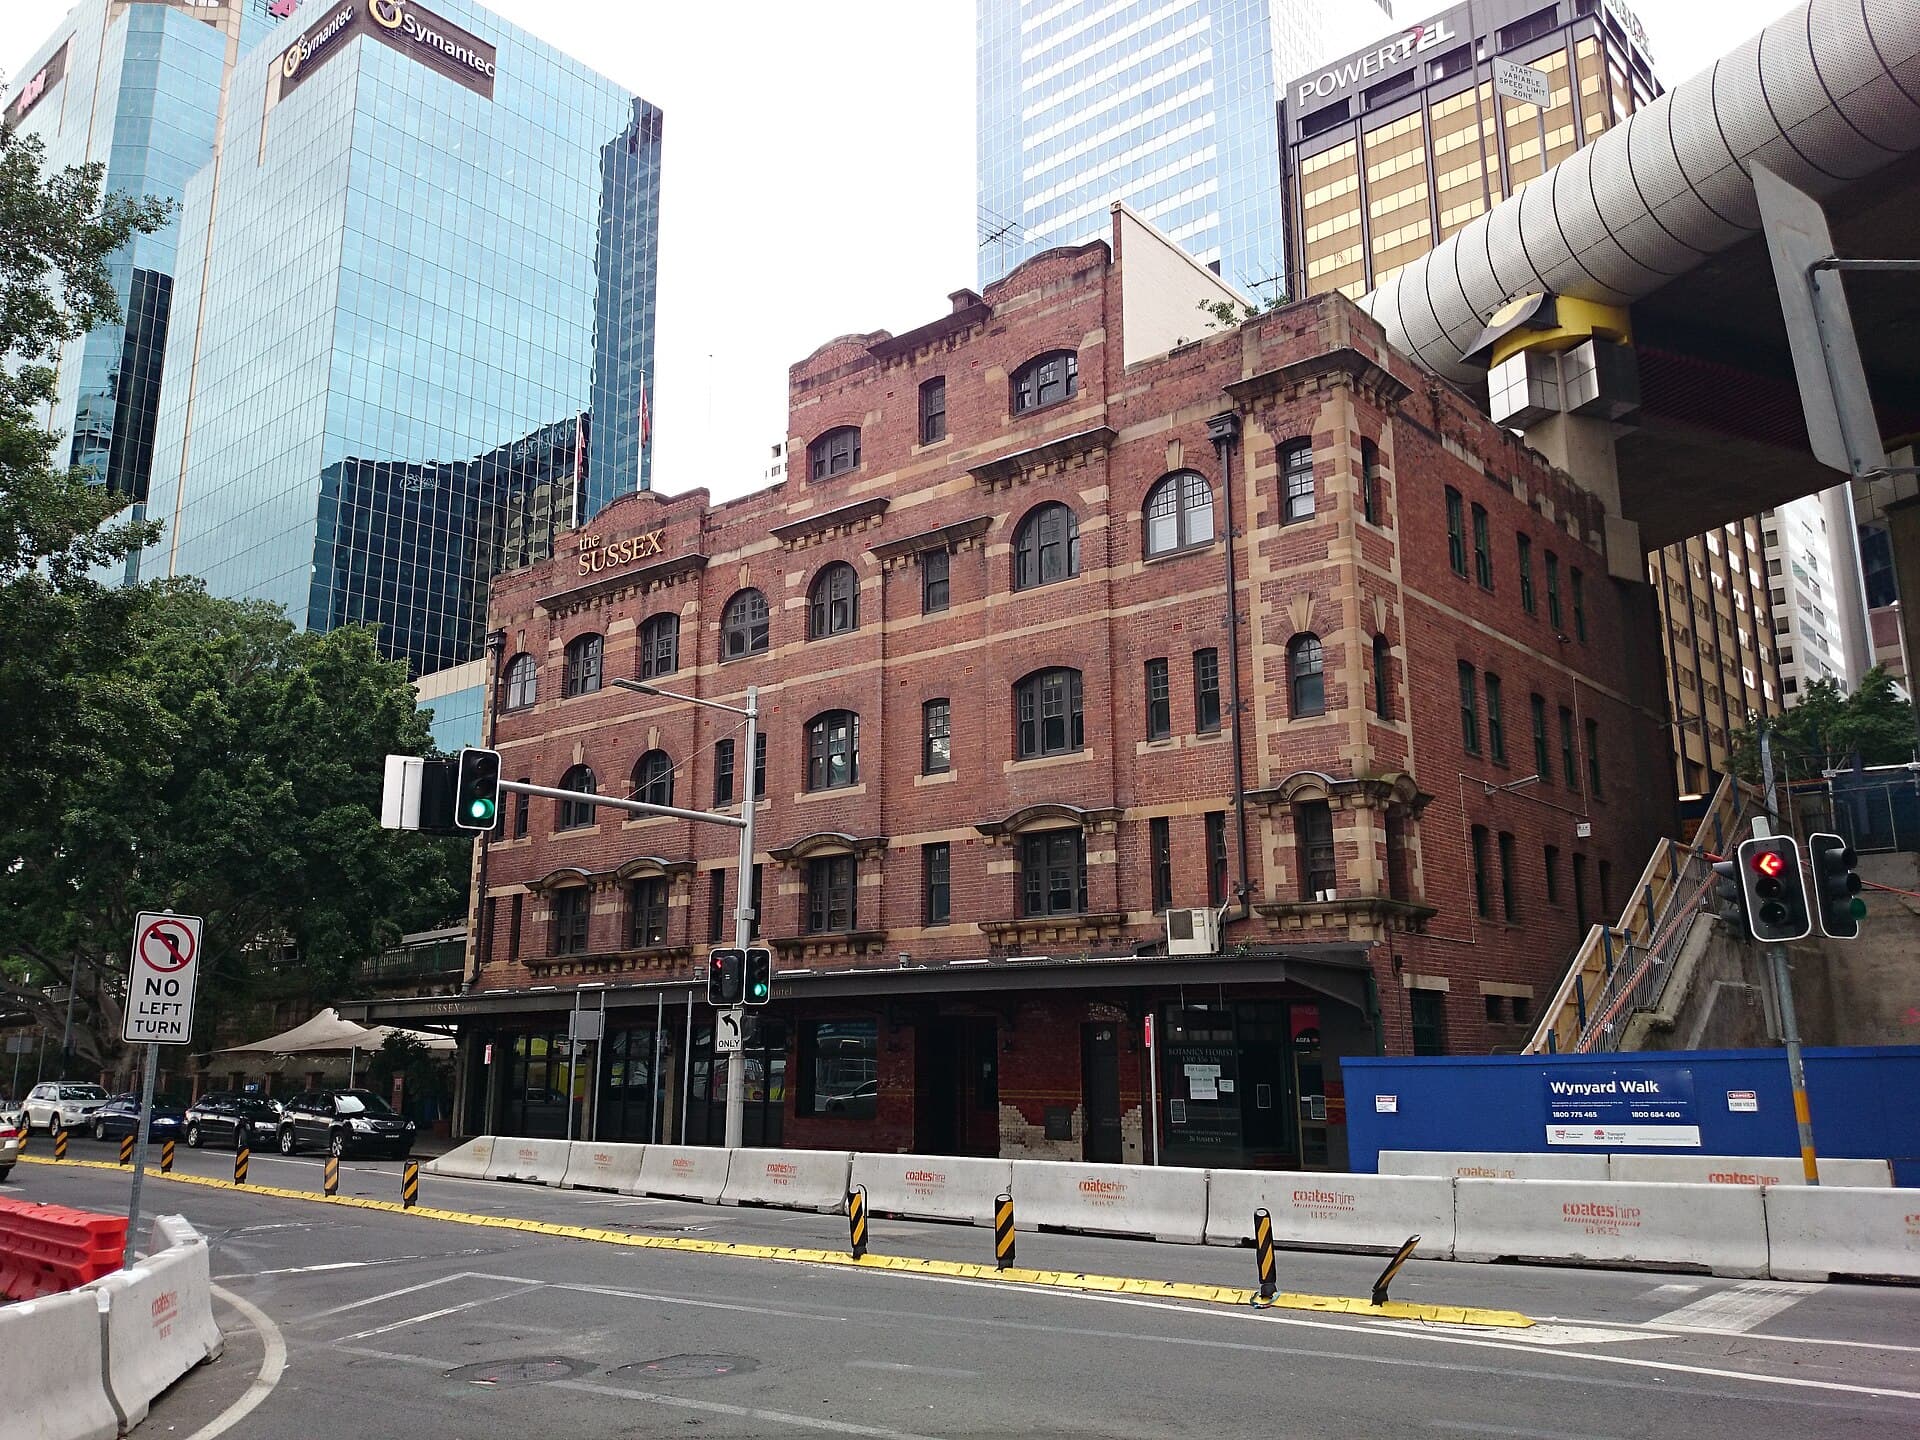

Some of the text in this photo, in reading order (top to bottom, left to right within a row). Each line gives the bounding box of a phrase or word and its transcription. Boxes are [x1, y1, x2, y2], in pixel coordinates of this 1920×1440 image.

[300, 5, 354, 61] Symantec
[402, 14, 495, 77] Symantec
[1299, 20, 1456, 107] POWERTEL
[1510, 65, 1533, 77] START
[1499, 77, 1546, 97] SPEED LIMIT
[1503, 71, 1541, 87] VARIABLE
[1513, 89, 1533, 101] ZONE
[579, 533, 601, 551] the
[578, 529, 664, 577] SUSSEX
[145, 978, 180, 997] NO
[139, 1001, 183, 1016] LEFT
[134, 1019, 182, 1035] TURN
[718, 1040, 741, 1049] ONLY
[1550, 1080, 1660, 1096] Wynyard Walk
